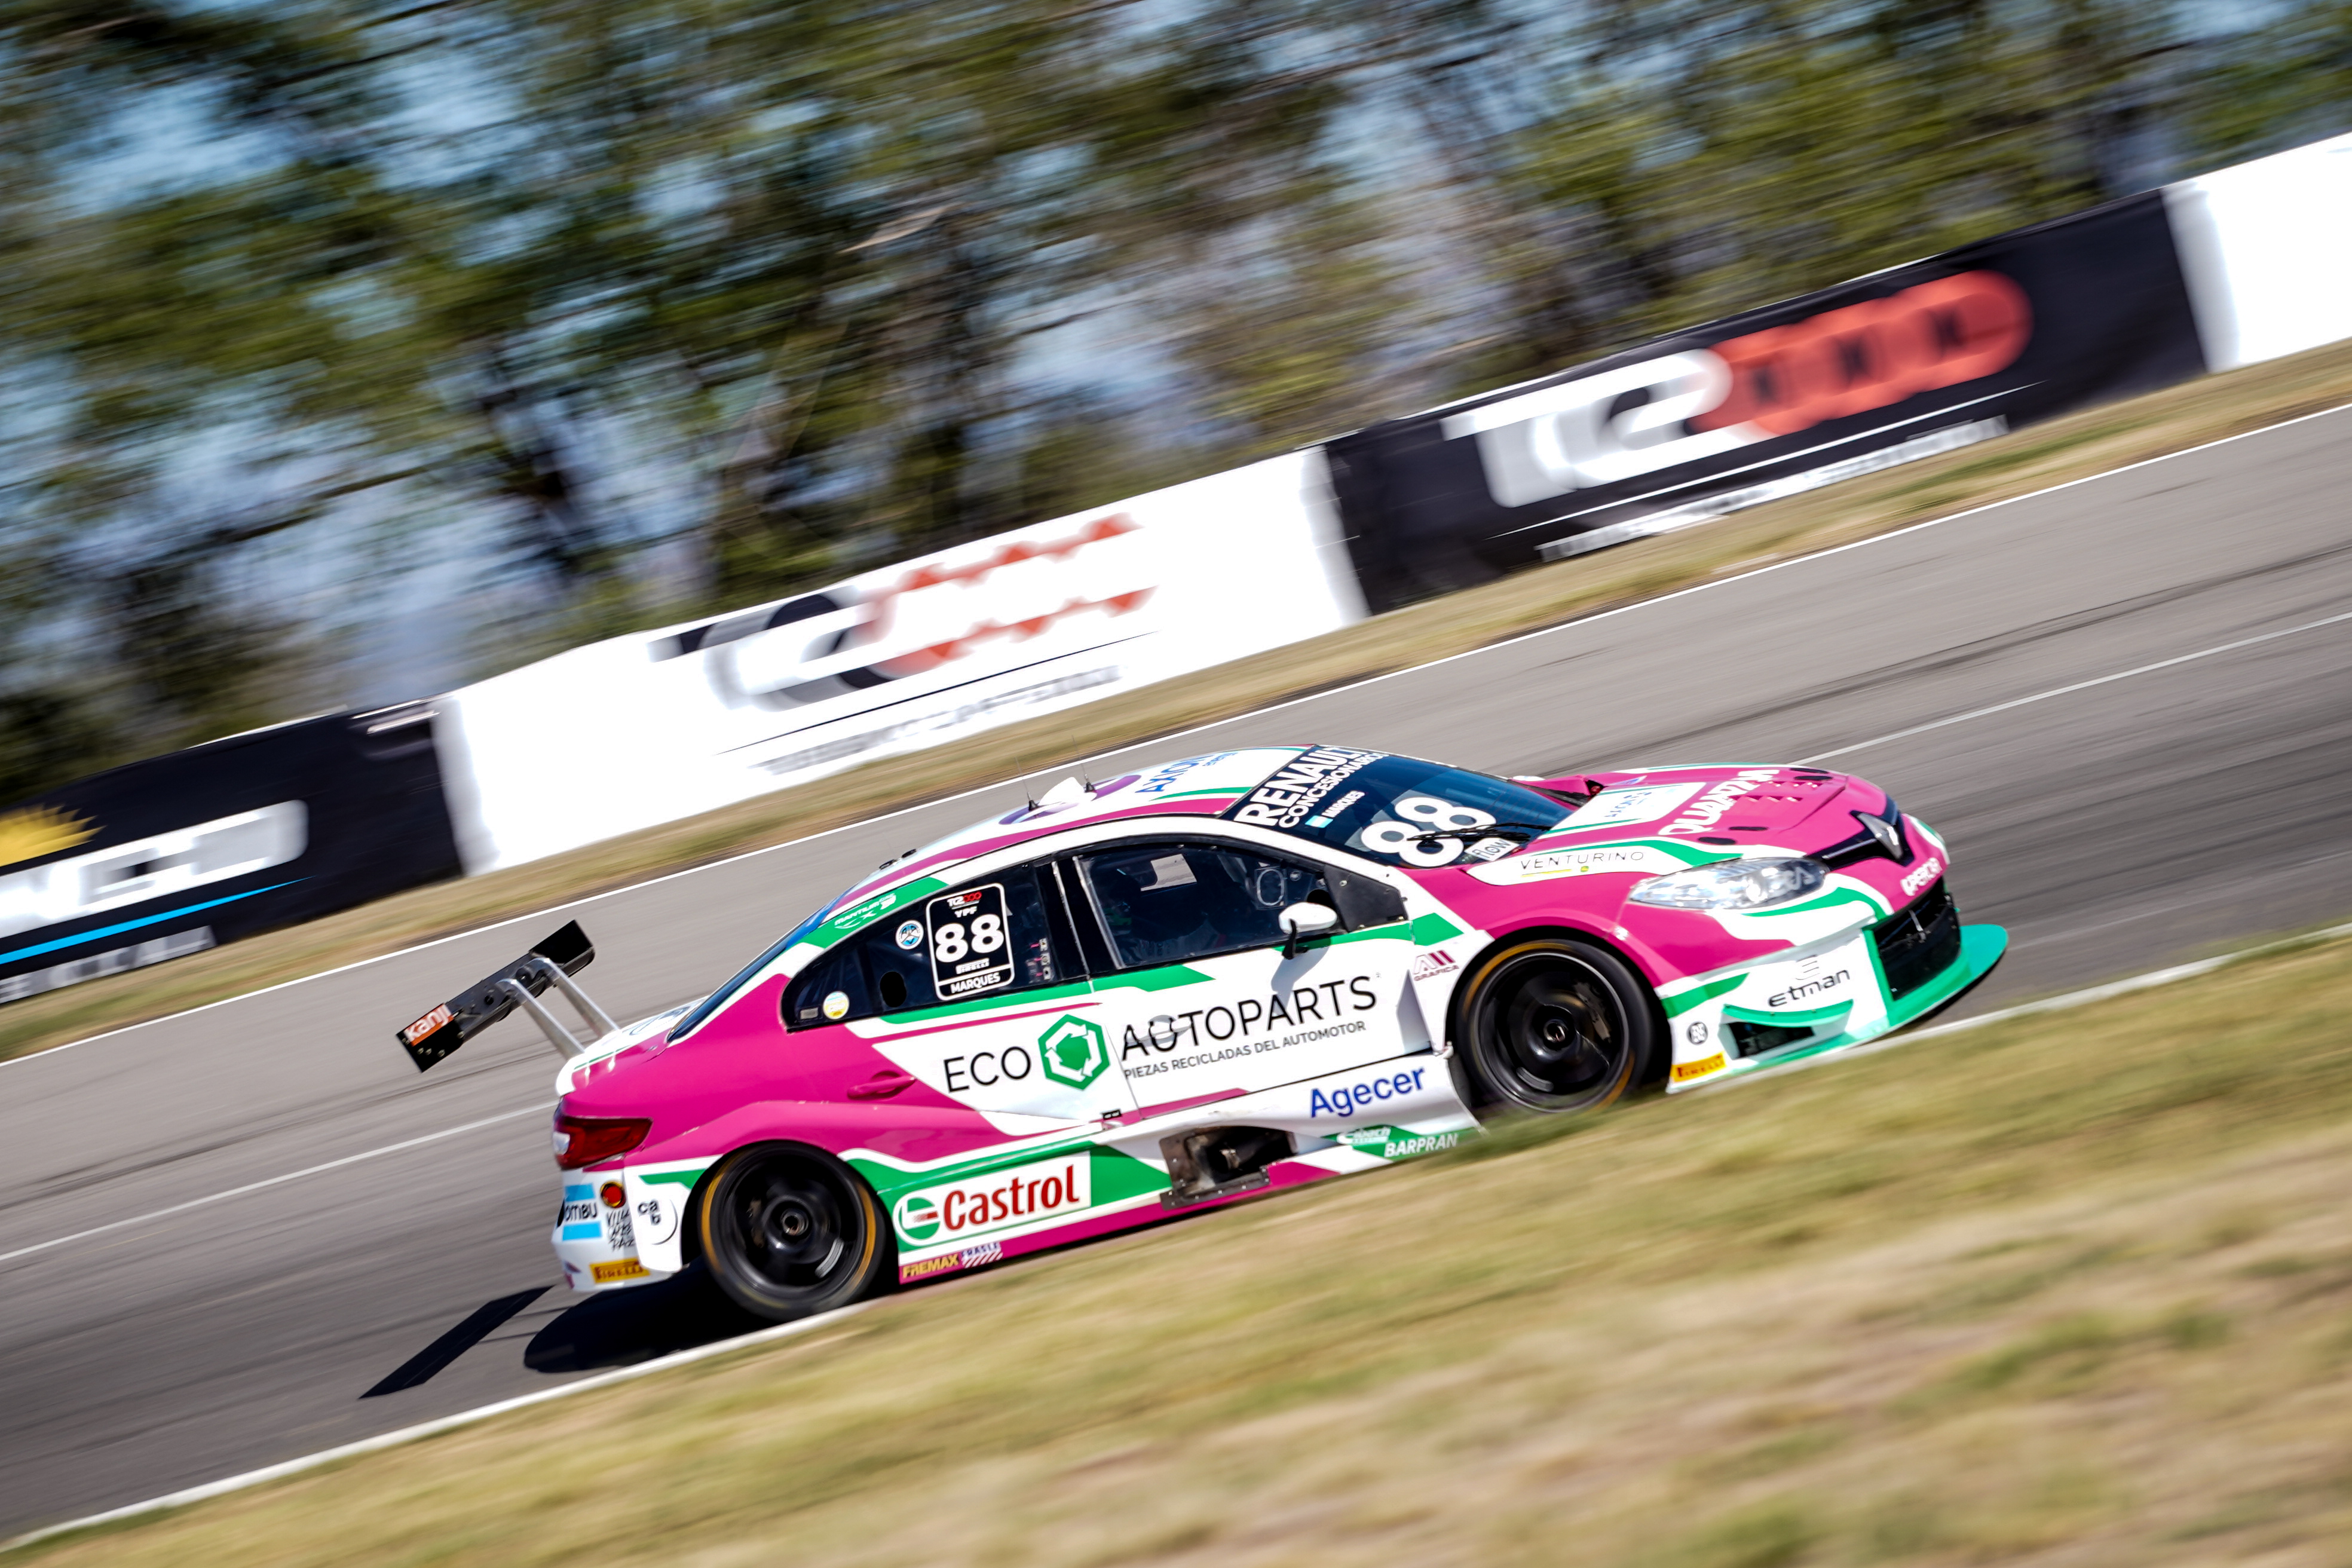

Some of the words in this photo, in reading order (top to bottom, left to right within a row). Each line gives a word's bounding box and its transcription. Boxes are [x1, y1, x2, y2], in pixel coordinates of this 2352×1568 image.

[1233, 747, 1368, 826] RENAULT
[1361, 797, 1497, 867] 88
[1520, 851, 1643, 869] VENTURINO
[947, 891, 982, 906] TC2000
[954, 906, 978, 918] YPF
[935, 914, 1004, 963] 88
[950, 972, 1001, 994] MARQUES
[1768, 969, 1851, 1007] etman
[403, 1003, 452, 1042] kanji
[943, 1046, 1032, 1094] ECO
[1122, 975, 1377, 1061] AUTOPARTS
[1124, 1061, 1169, 1080] PIEZAS
[1172, 1046, 1252, 1070] RECICLADAS
[1255, 1040, 1280, 1054] DEL
[1282, 1020, 1367, 1048] AUTOMOTOR
[1311, 1067, 1425, 1117] Agecer
[1384, 1133, 1458, 1157] BARPRAN
[944, 1164, 1080, 1231] Castrol
[902, 1254, 959, 1279] FREMAX
